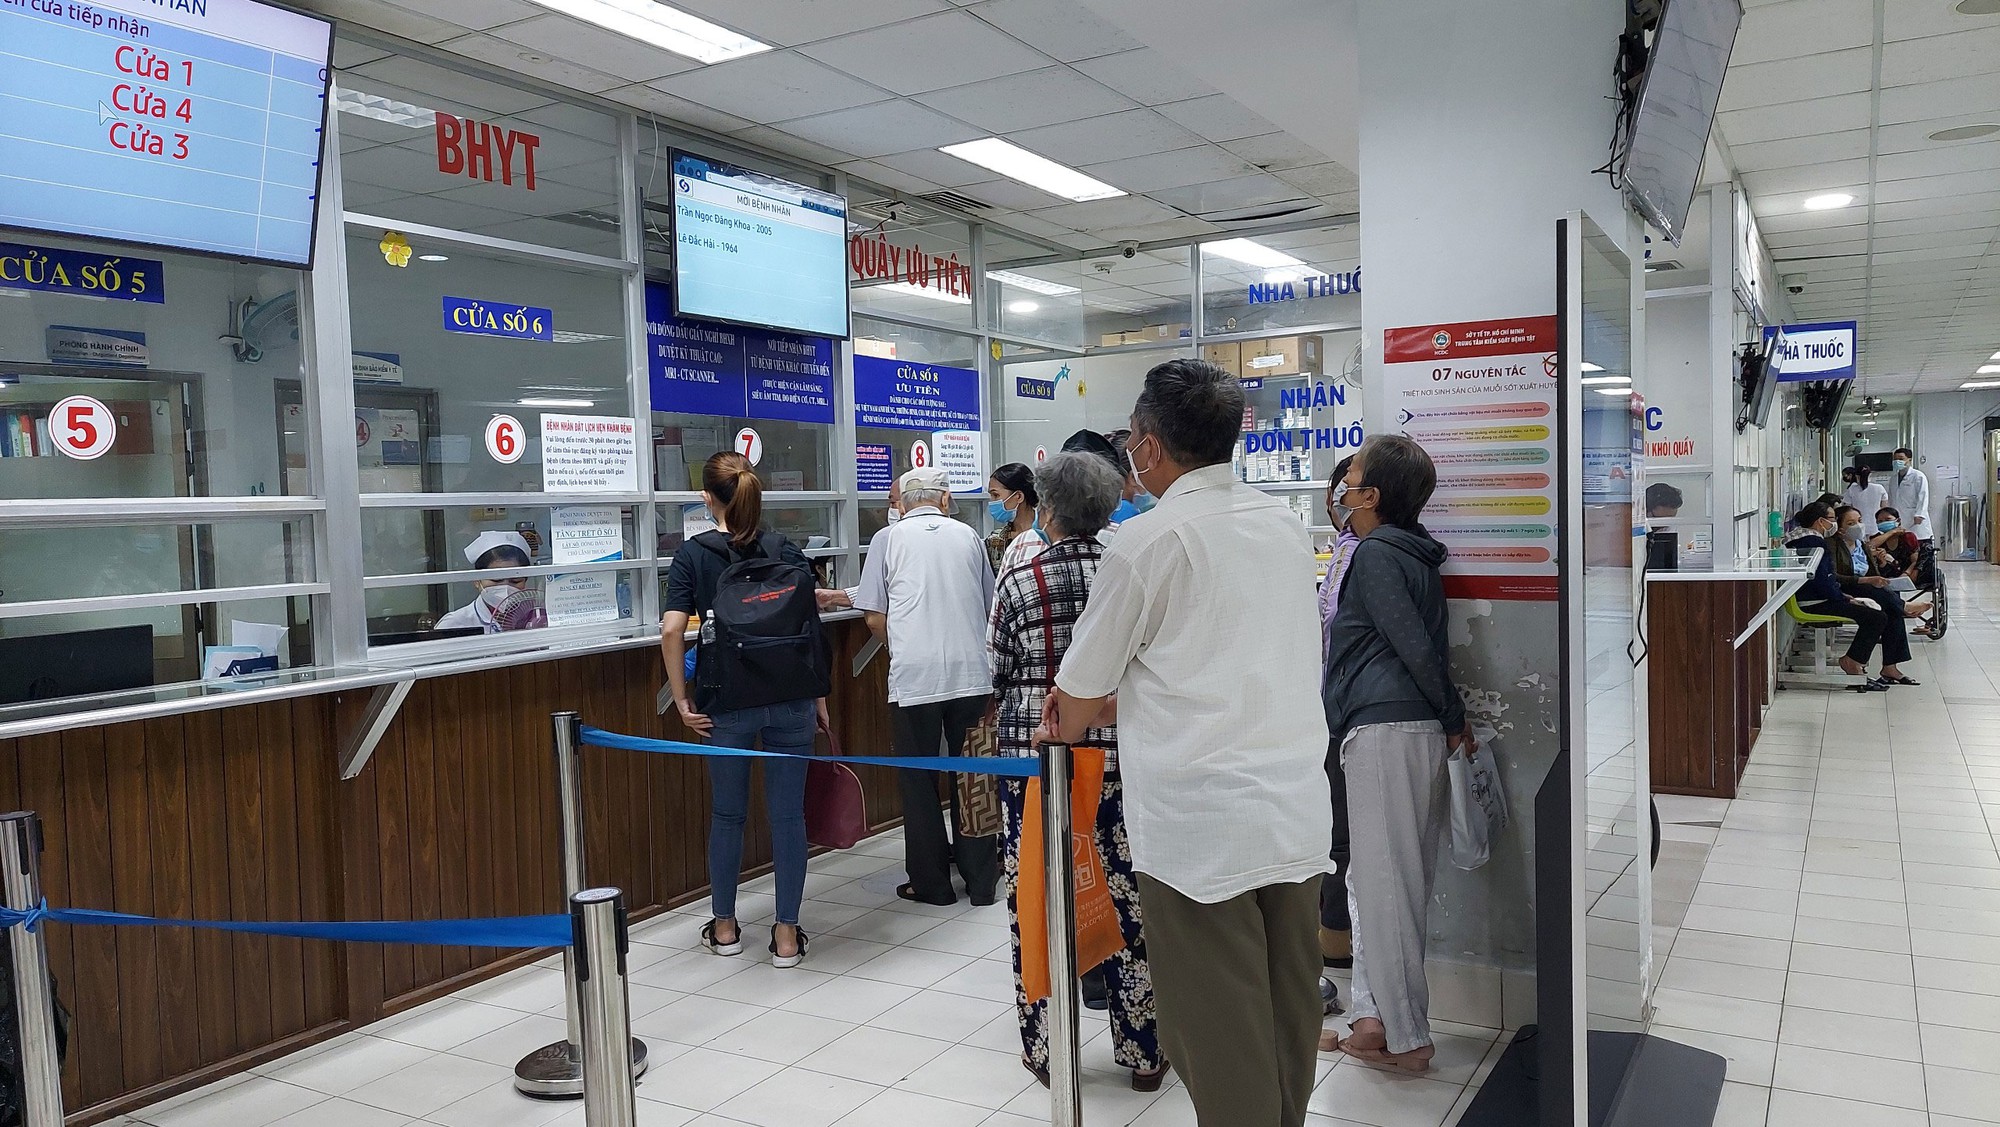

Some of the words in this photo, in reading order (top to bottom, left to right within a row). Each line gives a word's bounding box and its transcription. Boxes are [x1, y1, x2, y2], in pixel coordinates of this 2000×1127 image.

[68, 6, 103, 28] tiếp
[108, 16, 149, 38] nhận
[115, 45, 169, 82] Cửa
[182, 61, 193, 86] 1
[112, 84, 166, 120] Cửa
[175, 98, 192, 124] 4
[109, 122, 164, 156] Cửa
[173, 133, 190, 160] 3
[435, 111, 540, 191] BHYT
[677, 204, 694, 218] Trần
[695, 210, 713, 224] Ngọc
[714, 215, 733, 229] Đăng
[734, 219, 750, 231] Khoa
[756, 224, 773, 236] 2005
[736, 195, 751, 206] MỜI
[752, 199, 771, 212] BỆNH
[772, 203, 791, 217] NHÂN
[678, 232, 687, 244] Lê
[703, 237, 715, 249] Hải
[721, 242, 738, 254] 1964
[0, 249, 72, 288] CỬA
[81, 258, 122, 291] SỐ
[131, 271, 146, 294] 5
[851, 223, 901, 282] QUẦY
[906, 244, 928, 288] ƯU
[934, 252, 971, 299] TIÊN
[453, 302, 498, 331] CỬA
[503, 307, 527, 332] SỐ
[532, 316, 543, 334] 6
[90, 342, 113, 352] HÀNH
[114, 344, 139, 353] CHÍNH
[1784, 341, 1800, 360] HÀ
[1804, 336, 1844, 360] THUỐC
[897, 365, 917, 380] CỬA
[919, 367, 932, 382] SỐ
[933, 372, 939, 383] 8
[1432, 368, 1452, 382] 07
[1455, 366, 1503, 380] NGUYÊN
[1505, 363, 1527, 377] TẮC
[896, 383, 912, 393] ƯU
[914, 385, 940, 396] TIÊN
[1021, 380, 1035, 396] CỬA
[1036, 382, 1046, 396] SỐ
[1046, 388, 1051, 397] 9
[1280, 381, 1346, 412] NHẬN
[1434, 388, 1451, 396] SINH
[67, 406, 98, 450] 5
[496, 423, 514, 455] 6
[546, 419, 559, 432] BỆNH
[560, 420, 574, 432] NHÂN
[1245, 428, 1292, 454] ĐƠN
[1300, 418, 1363, 450] THUỐ
[742, 434, 754, 459] 7
[916, 445, 925, 467] 8
[1652, 436, 1671, 457] KHỎI
